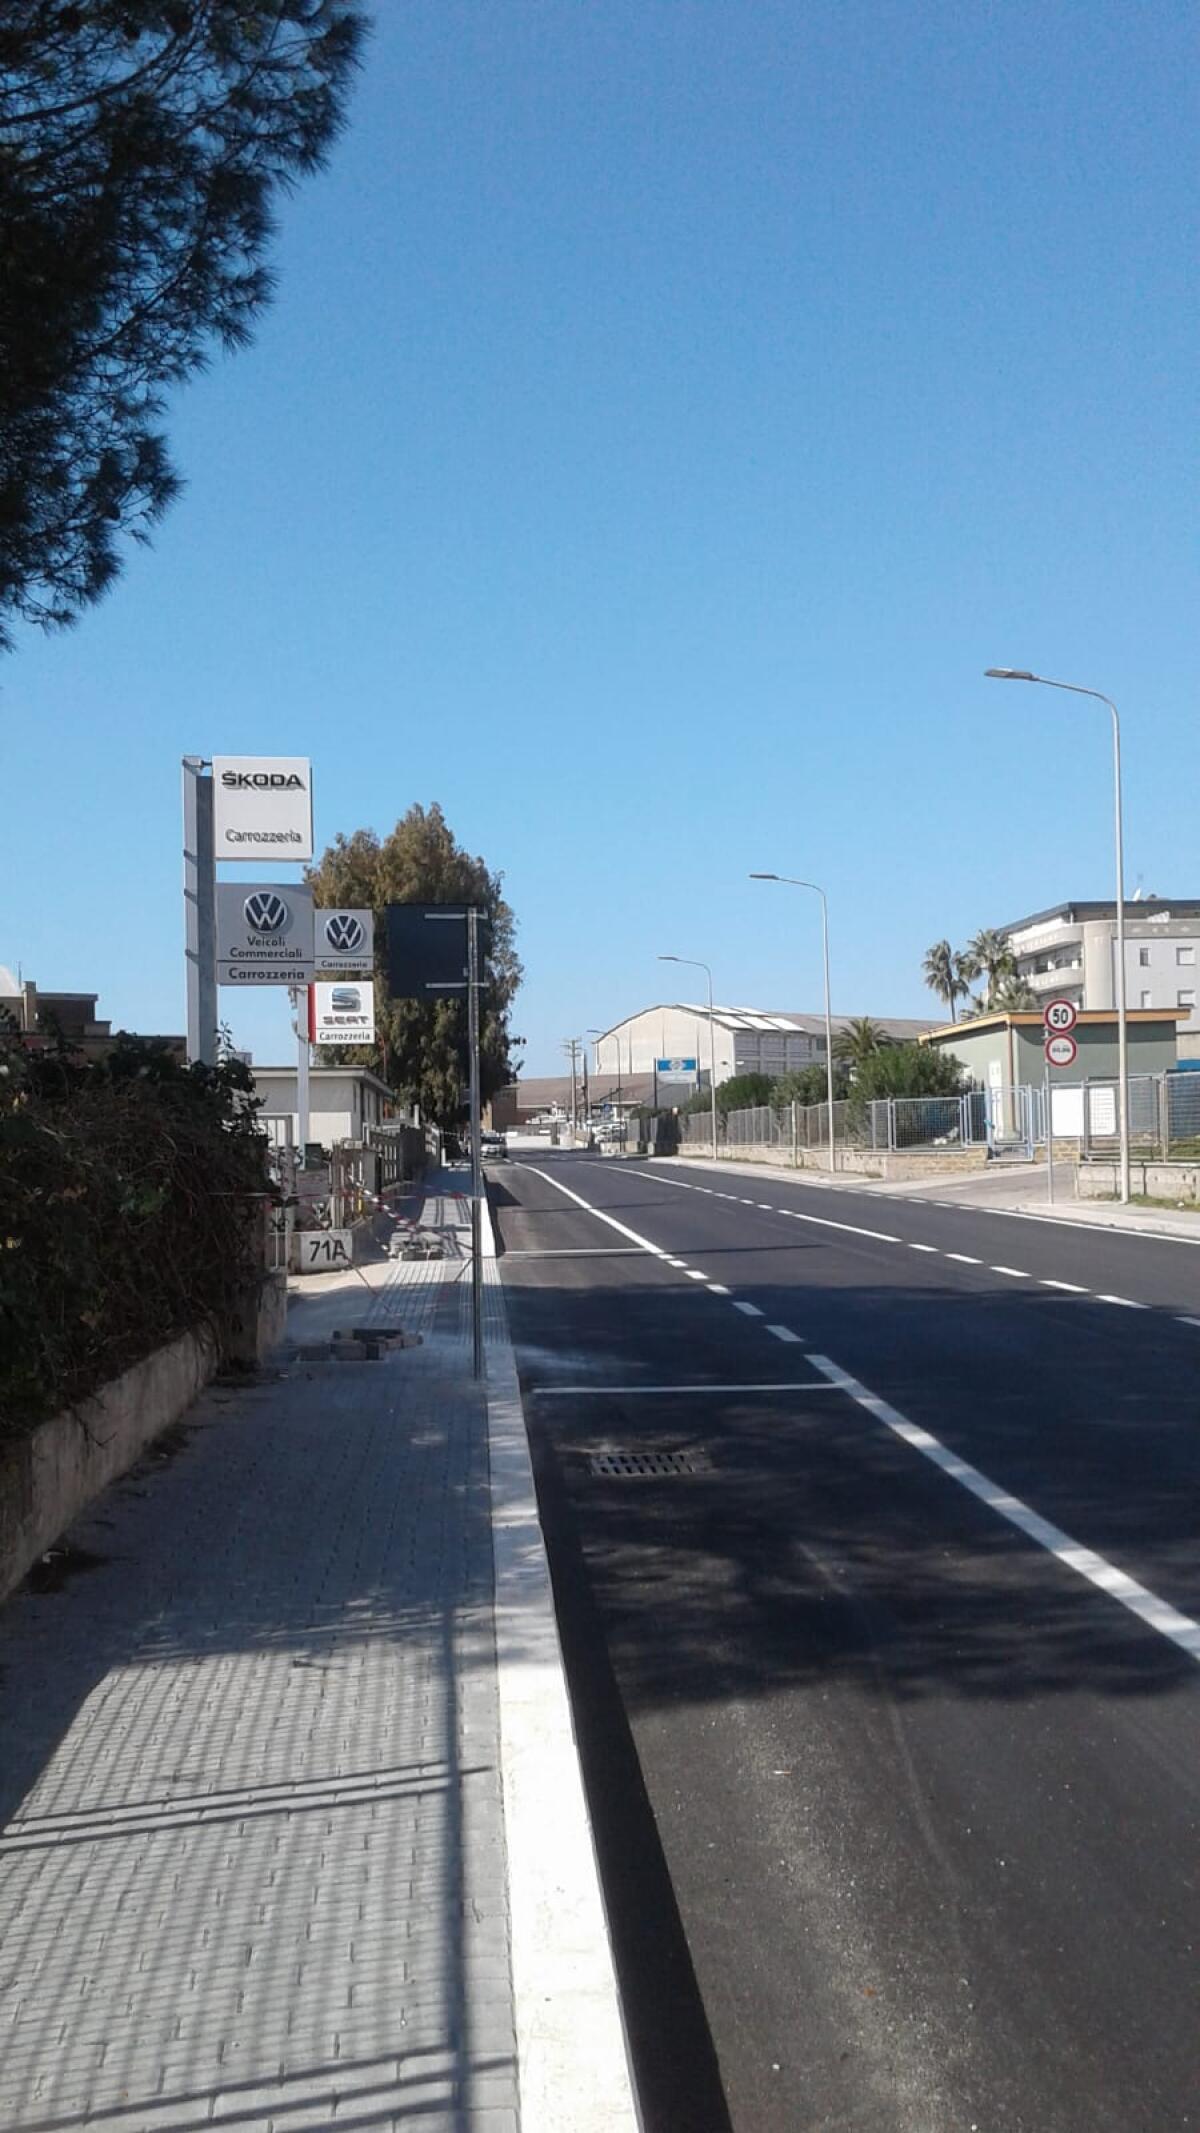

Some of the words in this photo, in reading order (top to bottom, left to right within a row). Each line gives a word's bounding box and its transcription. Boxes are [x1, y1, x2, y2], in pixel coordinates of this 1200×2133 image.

[221, 770, 303, 788] ŠKODA
[225, 829, 303, 844] Carrozzeria
[247, 936, 285, 946] Veicoli
[229, 947, 302, 958] Commerciali
[321, 959, 368, 968] Carrozzeria
[228, 968, 305, 980] Carrozzeria
[322, 1015, 369, 1025] SEAT
[1053, 1008, 1069, 1024] 50
[319, 1031, 370, 1041] Carrozzeria
[309, 1239, 347, 1262] 71A
